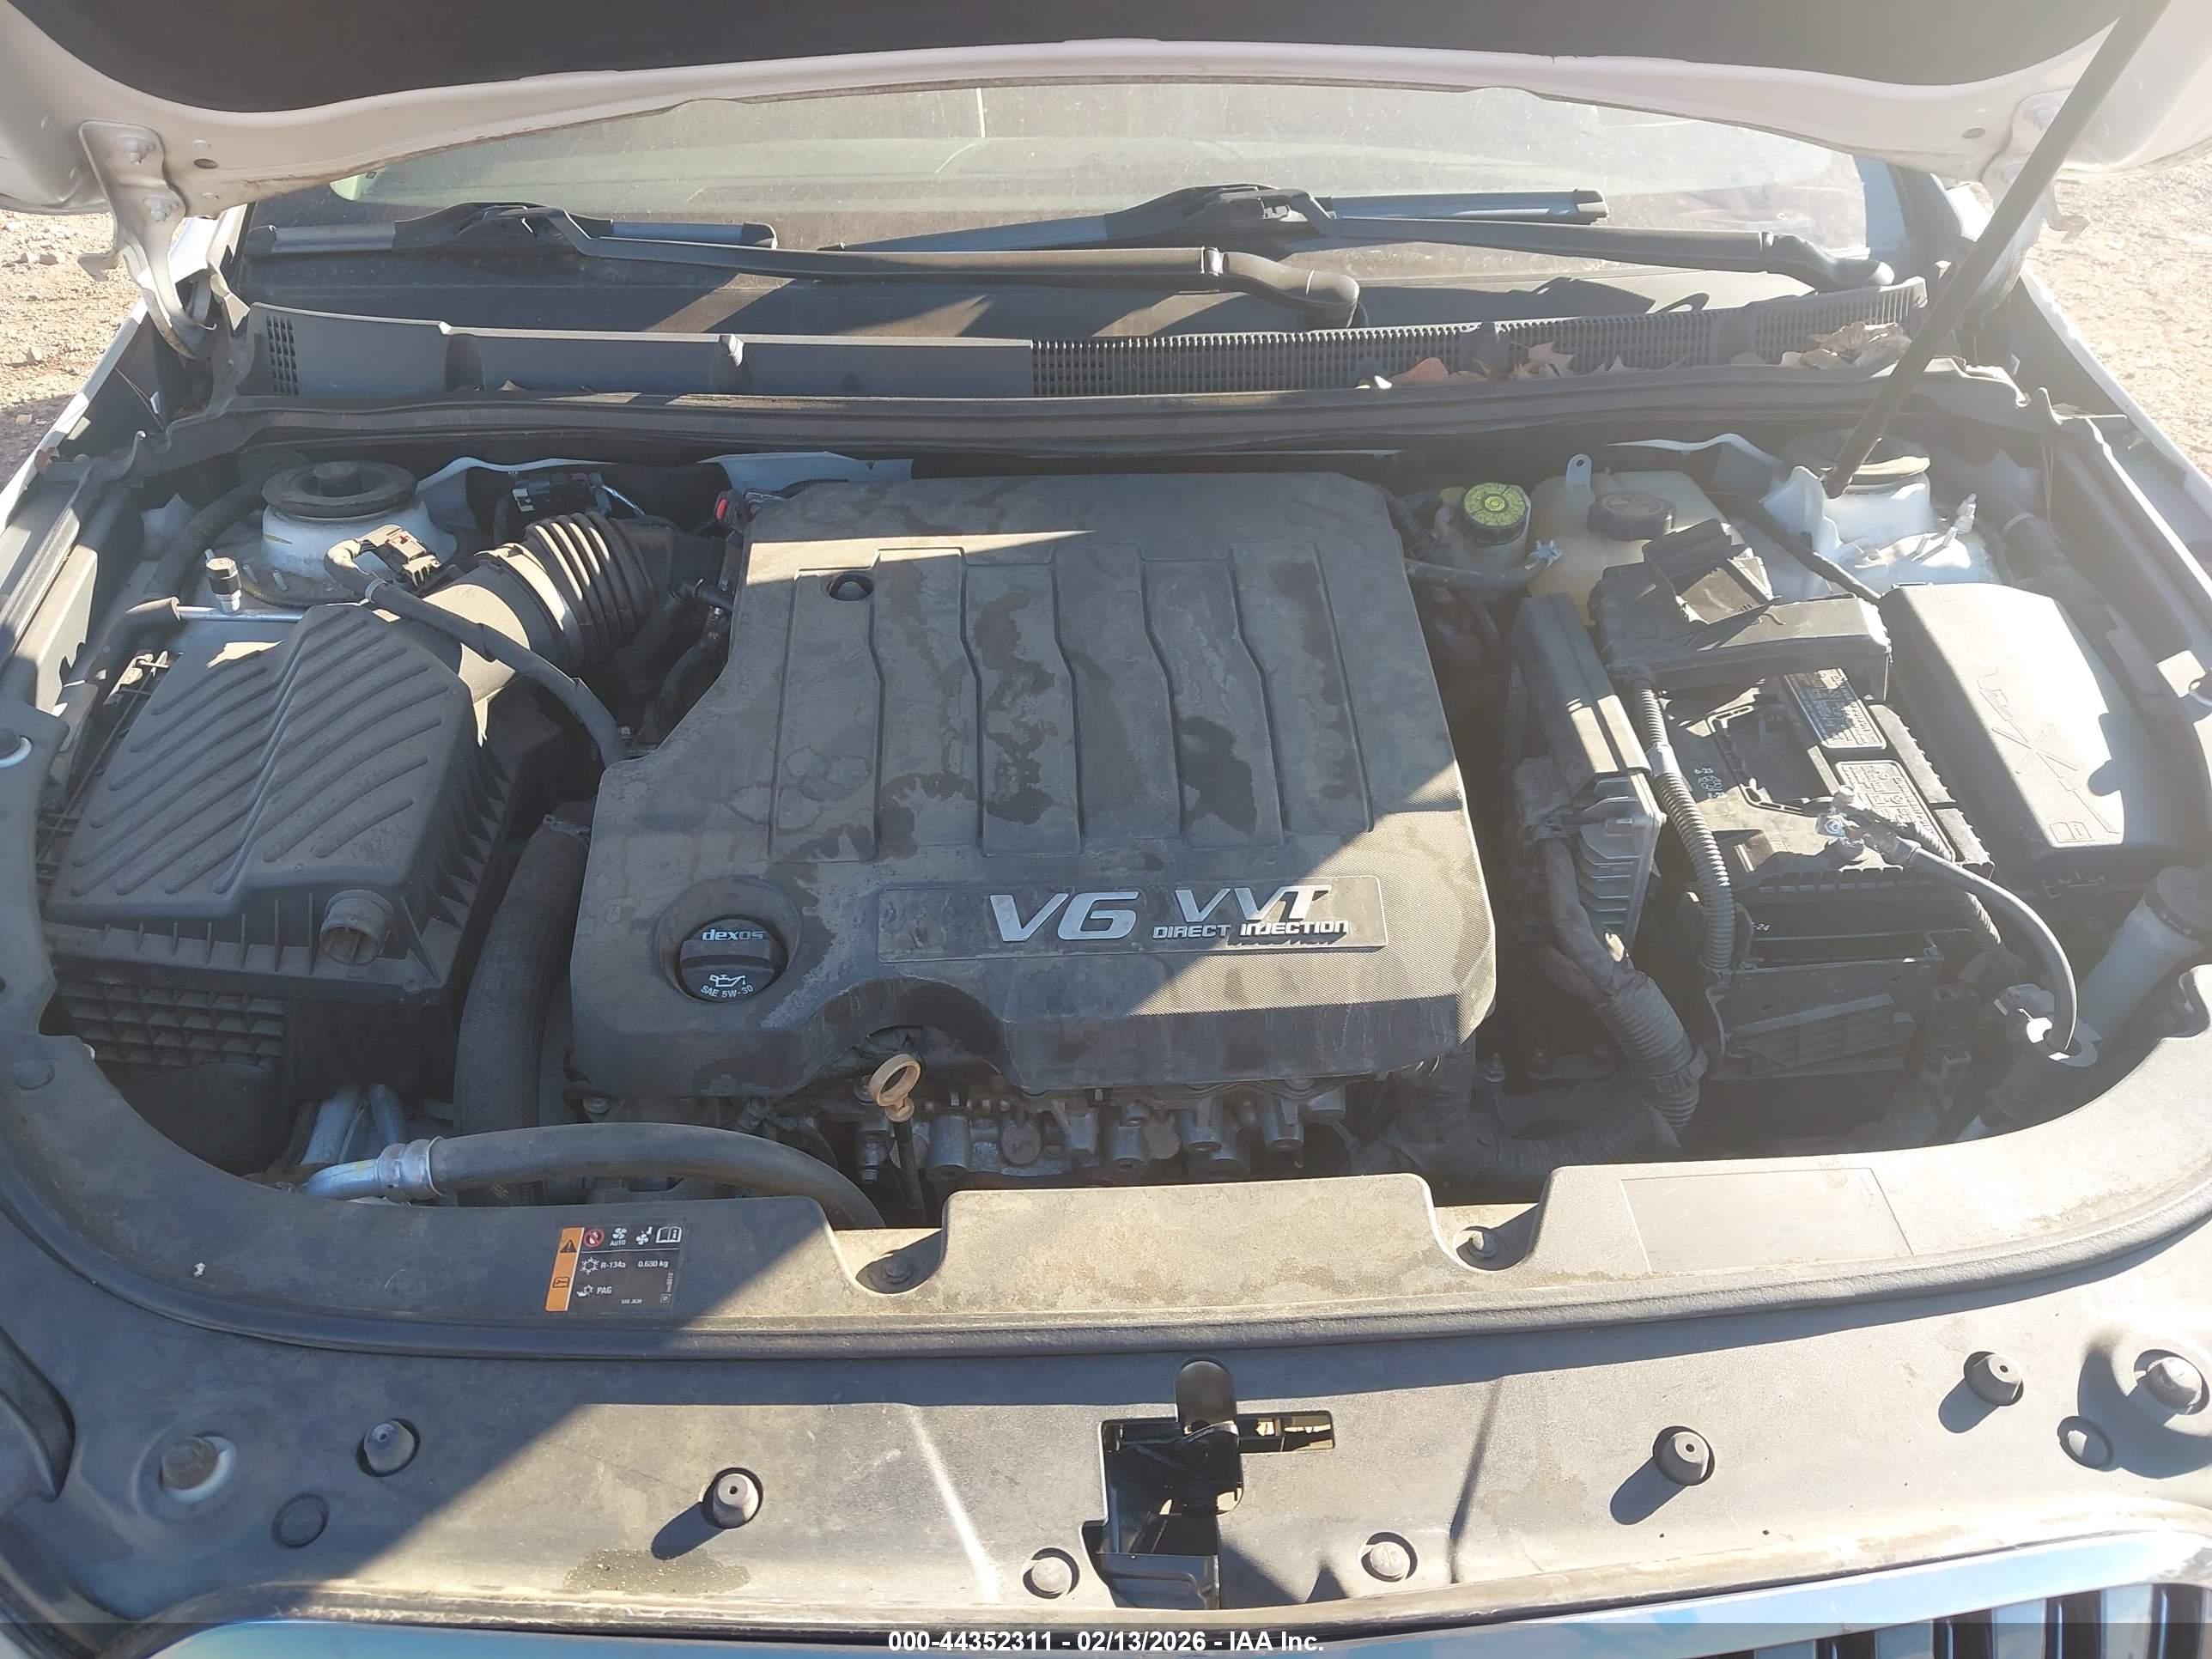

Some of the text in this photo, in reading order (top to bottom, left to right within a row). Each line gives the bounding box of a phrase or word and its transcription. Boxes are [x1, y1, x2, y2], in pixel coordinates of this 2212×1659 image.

[989, 884, 1333, 942] V6 VVT
[702, 929, 766, 941] dexos
[1152, 920, 1350, 939] DIRECT INJECTION
[701, 985, 754, 998] SAE 5W-30
[659, 1260, 669, 1268] kg
